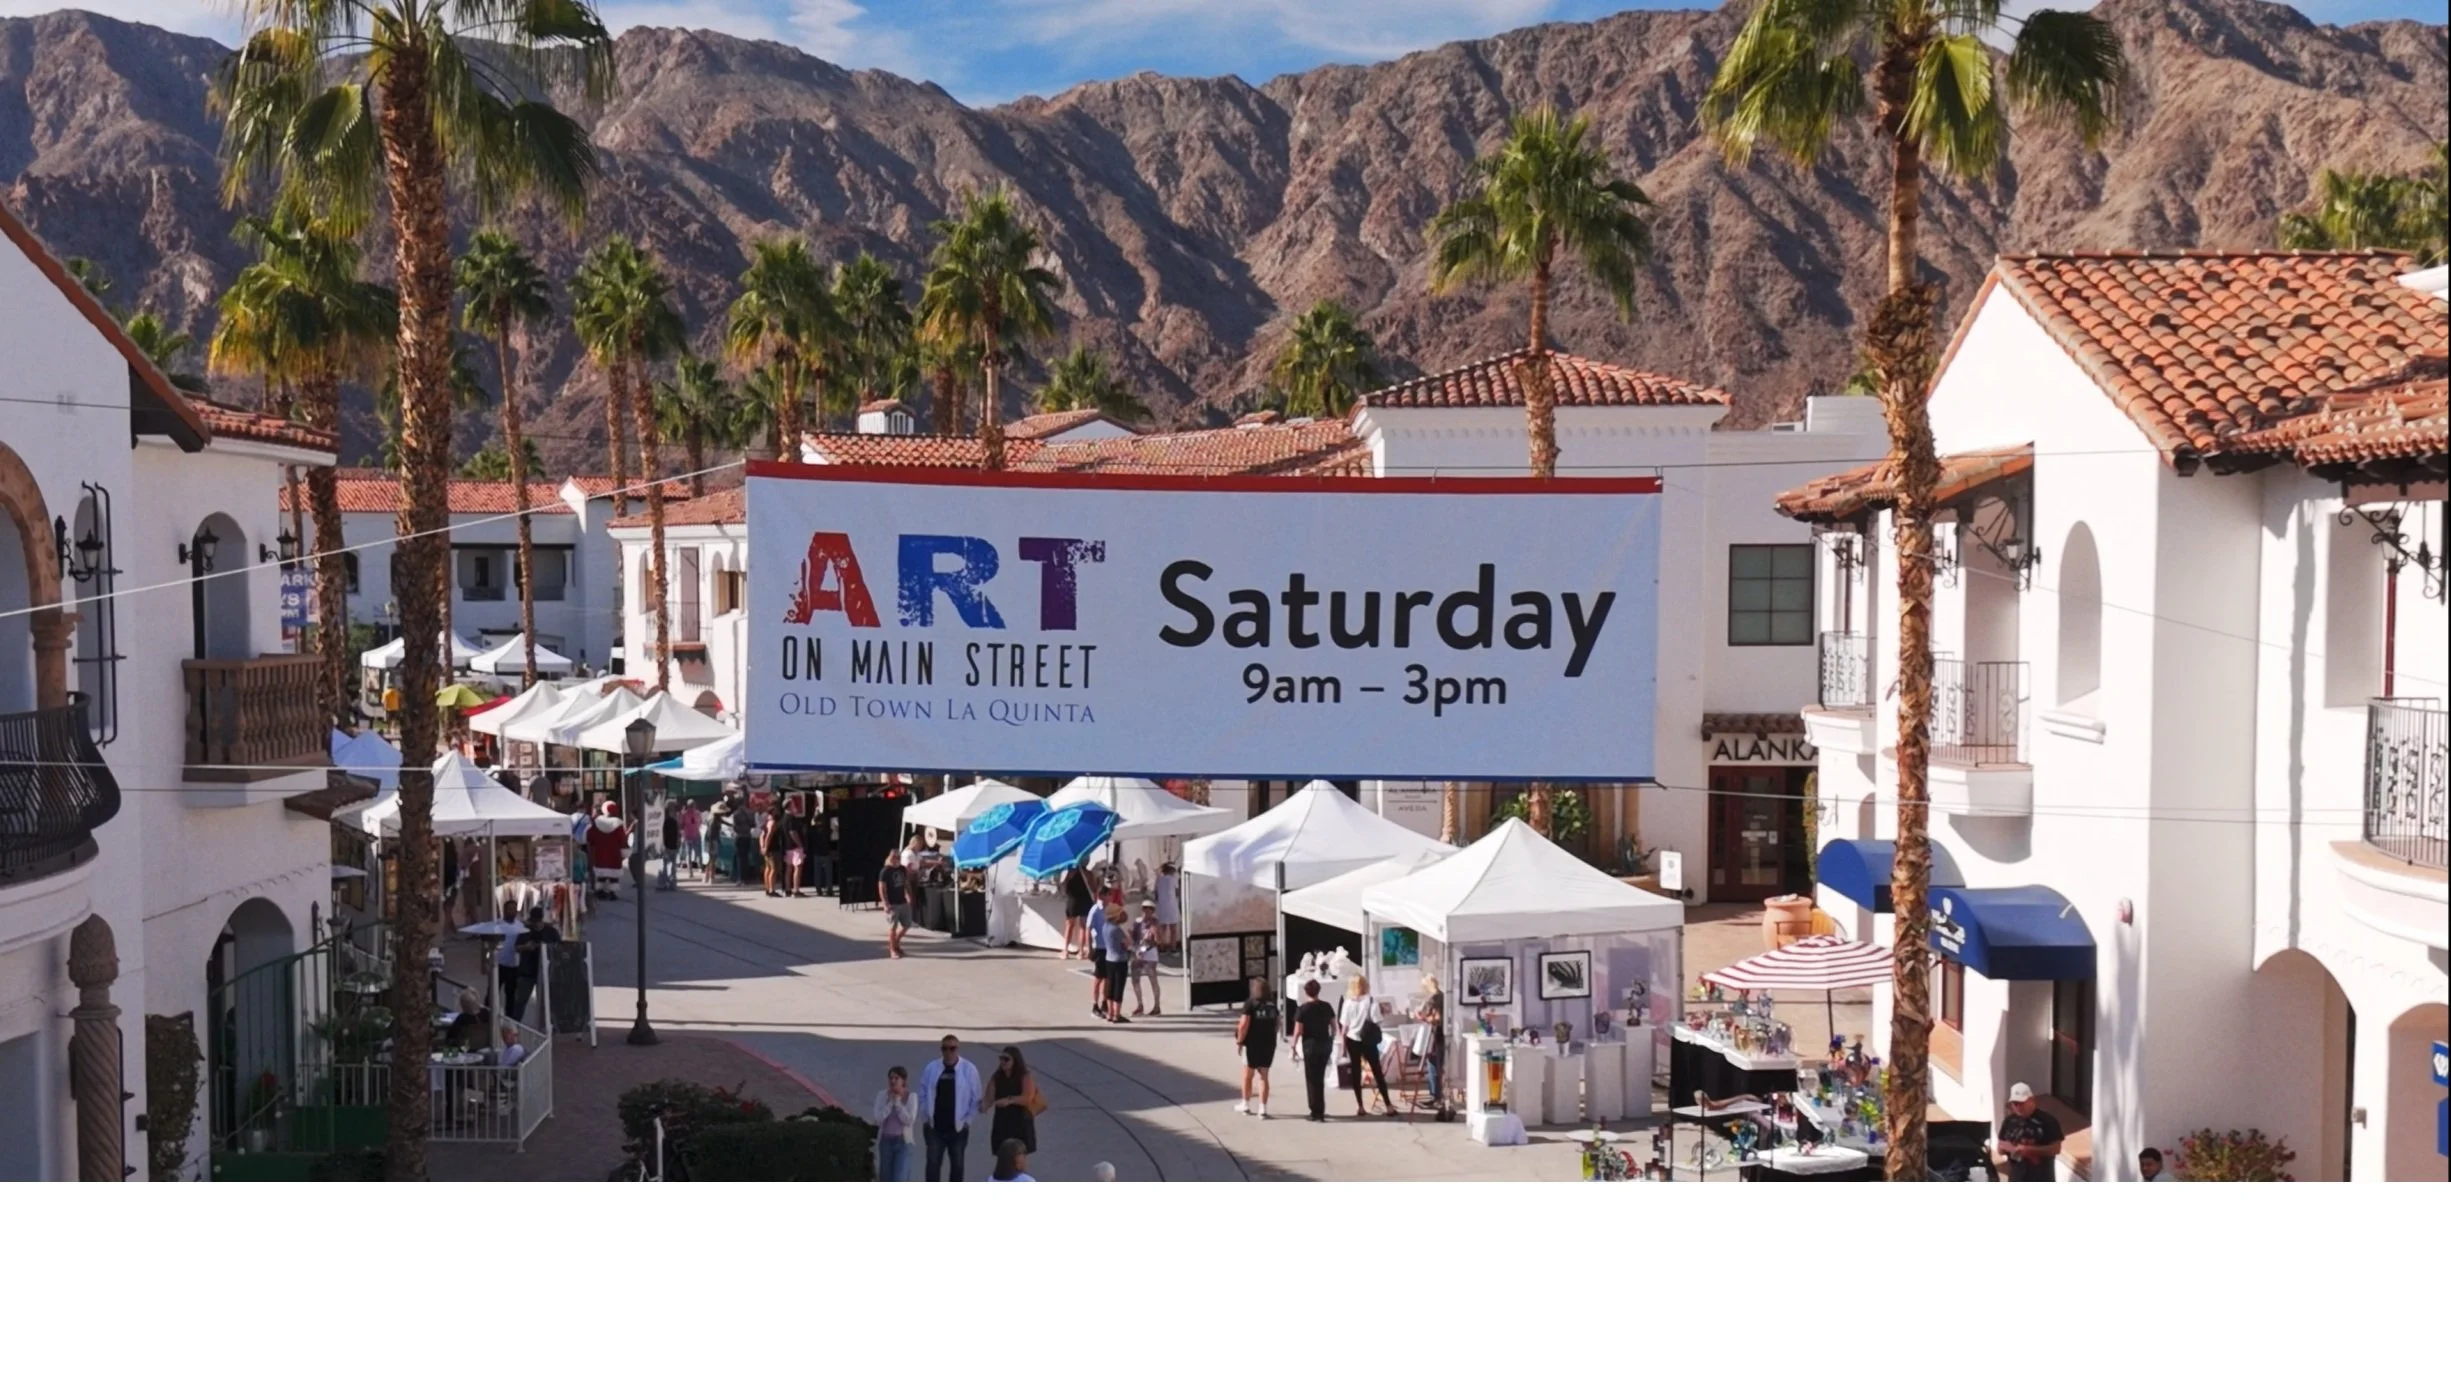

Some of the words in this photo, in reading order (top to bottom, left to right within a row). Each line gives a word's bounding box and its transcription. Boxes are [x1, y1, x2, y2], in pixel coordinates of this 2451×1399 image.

[783, 532, 1105, 631] ART
[1158, 560, 1617, 678] Saturday
[782, 635, 822, 681] ON
[851, 639, 934, 685] MAIN
[965, 642, 1098, 688] STREET
[779, 692, 837, 716] OLD
[849, 695, 932, 719] TOWN
[947, 698, 976, 721] LA
[989, 699, 1096, 726] QUINTA
[1242, 663, 1342, 704] 9am
[1402, 664, 1507, 717] 3pm
